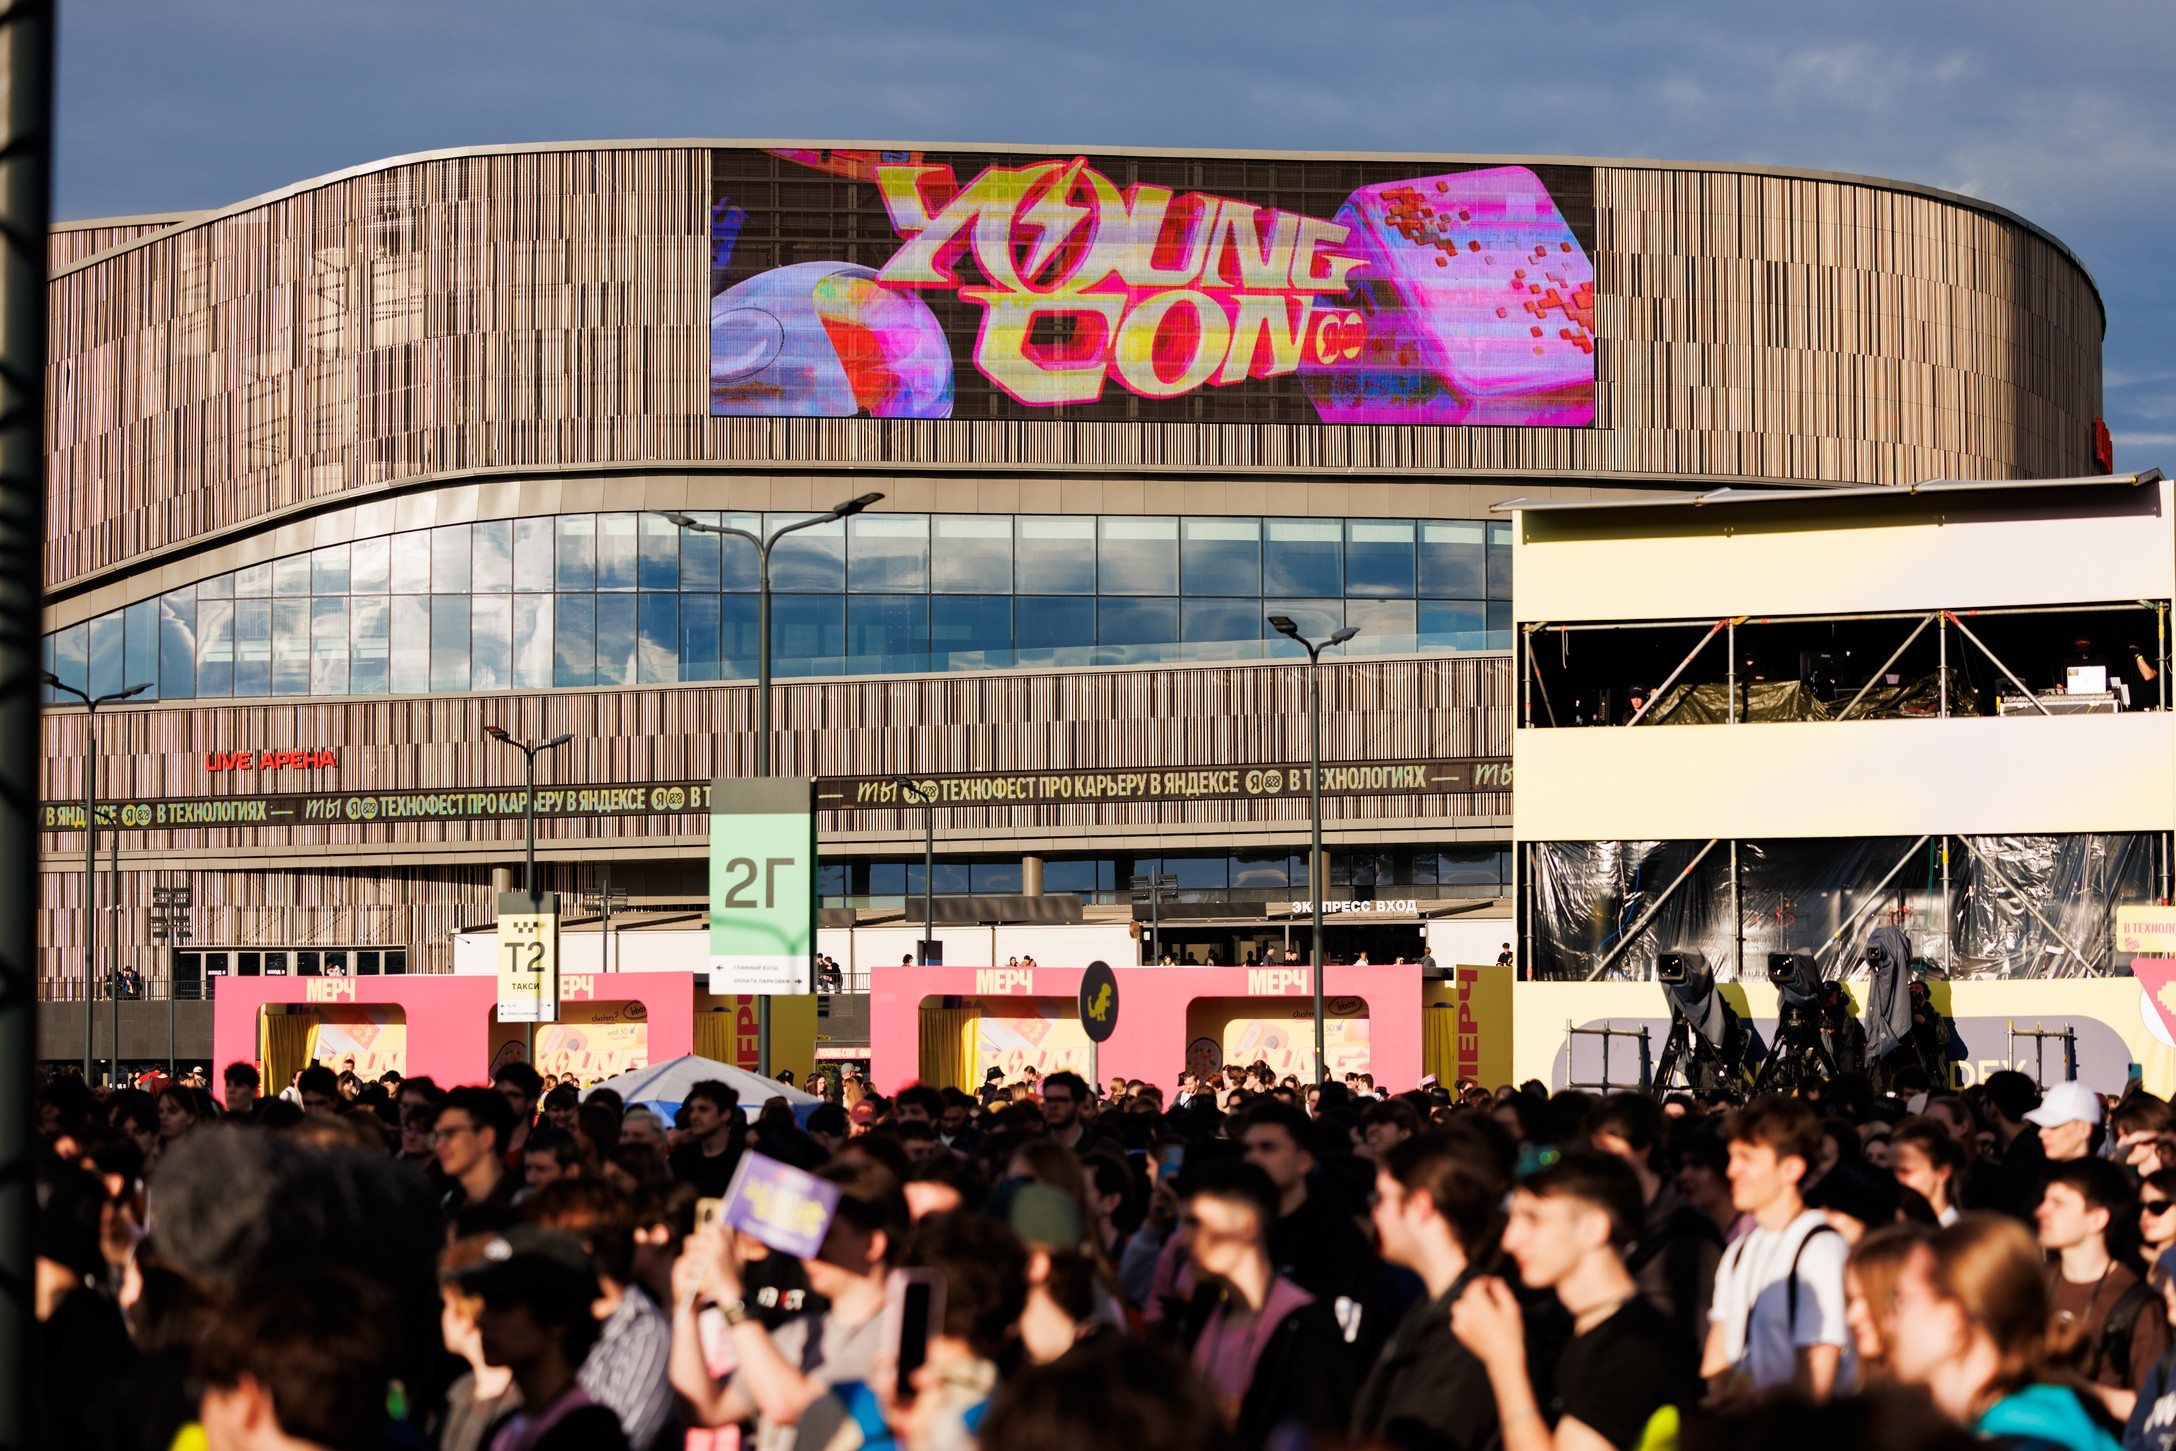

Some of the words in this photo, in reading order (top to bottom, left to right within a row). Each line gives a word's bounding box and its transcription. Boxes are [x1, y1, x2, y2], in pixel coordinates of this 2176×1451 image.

[873, 157, 1371, 294] YOUNG
[958, 289, 1316, 406] CON
[205, 752, 252, 771] LIVE
[260, 750, 337, 769] АРЕНА
[940, 776, 1036, 801] ТЕХНОФЕСТ
[1040, 775, 1071, 798] ПРО
[1074, 773, 1148, 797] КАРЬЕРУ
[1150, 773, 1161, 794] В
[1164, 770, 1239, 797] ЯНДЕКСЕ
[1289, 768, 1301, 791] В
[46, 806, 55, 826] В
[58, 805, 117, 828] ЯНДКСЕ
[157, 804, 166, 823] В
[168, 801, 267, 823] ТЕХНОЛОГИЯХ
[380, 794, 463, 817] ТЕХНОФЕСТ
[467, 793, 497, 815] ПРО
[566, 790, 577, 812] В
[579, 788, 646, 812] ЯНДЕКСЕ
[690, 786, 701, 808] В
[725, 857, 795, 909] 2Г
[1291, 900, 1371, 913] ЭКПРЕСС
[1376, 900, 1418, 914] ВХОД
[306, 978, 356, 1002] МЕРЧ
[512, 982, 540, 991] ТАКСИ
[560, 975, 595, 1000] ЕРЧ
[976, 969, 1033, 995] МЕРЧ
[1248, 969, 1308, 995] МЕРЧ
